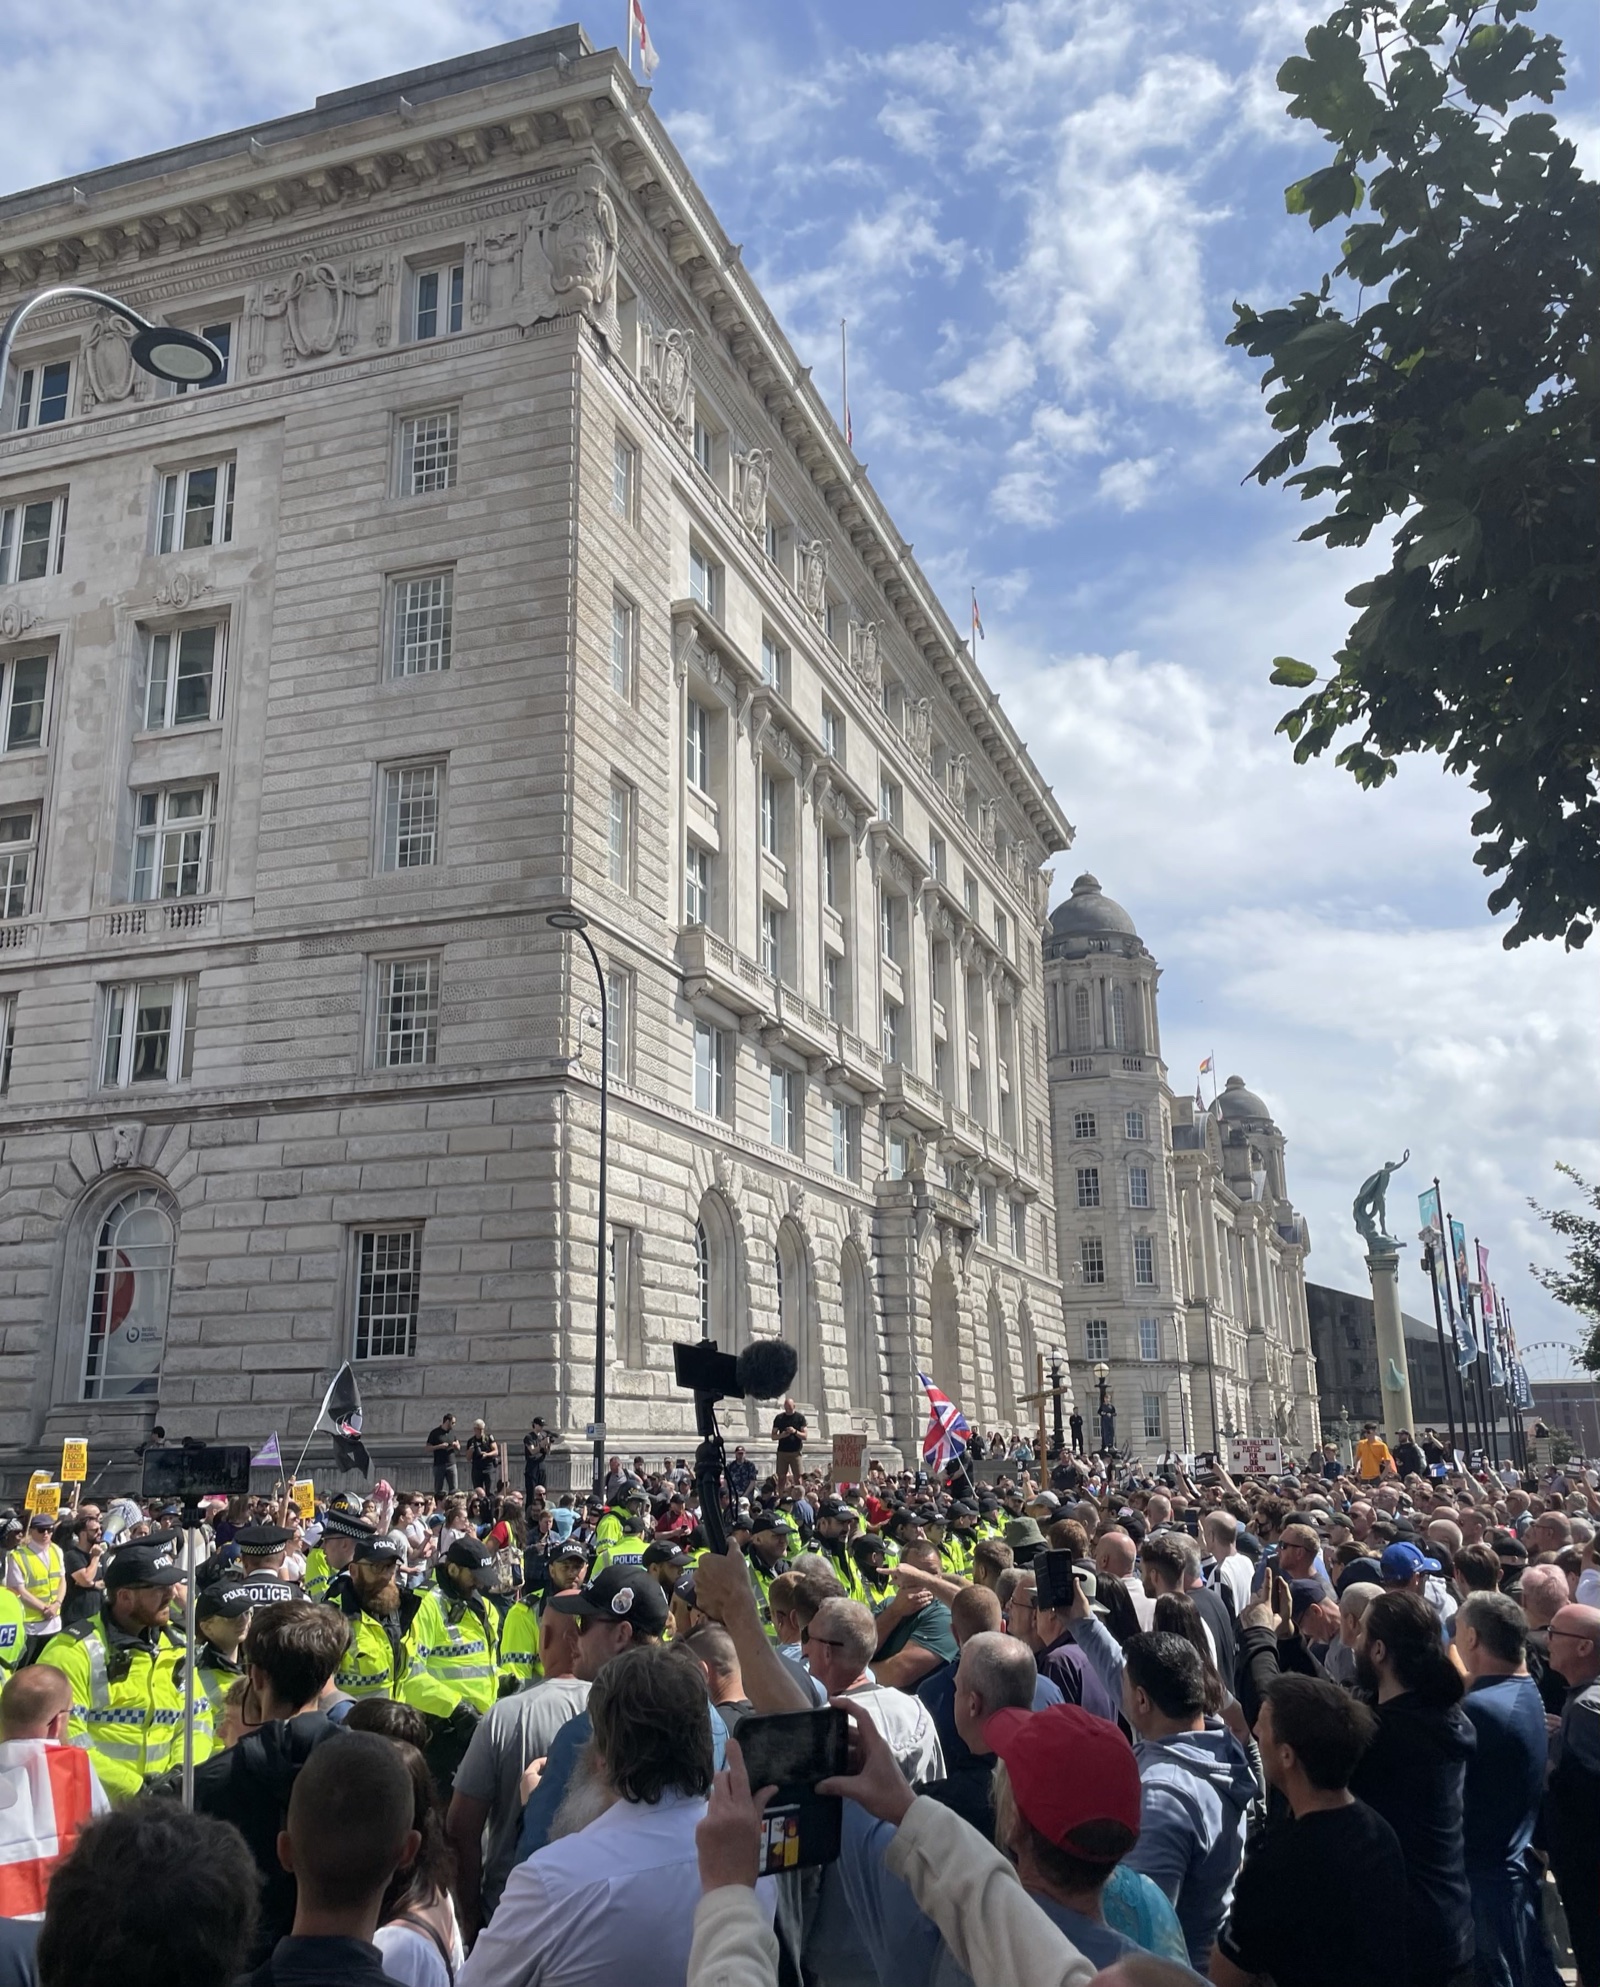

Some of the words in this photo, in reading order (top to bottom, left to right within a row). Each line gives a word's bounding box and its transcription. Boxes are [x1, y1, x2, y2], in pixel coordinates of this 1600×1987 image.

[840, 1436, 857, 1444] NOT
[36, 1497, 57, 1505] FASCISM
[562, 1544, 583, 1554] POLICE
[613, 1555, 643, 1565] POLICE
[249, 1588, 288, 1600] OLICE
